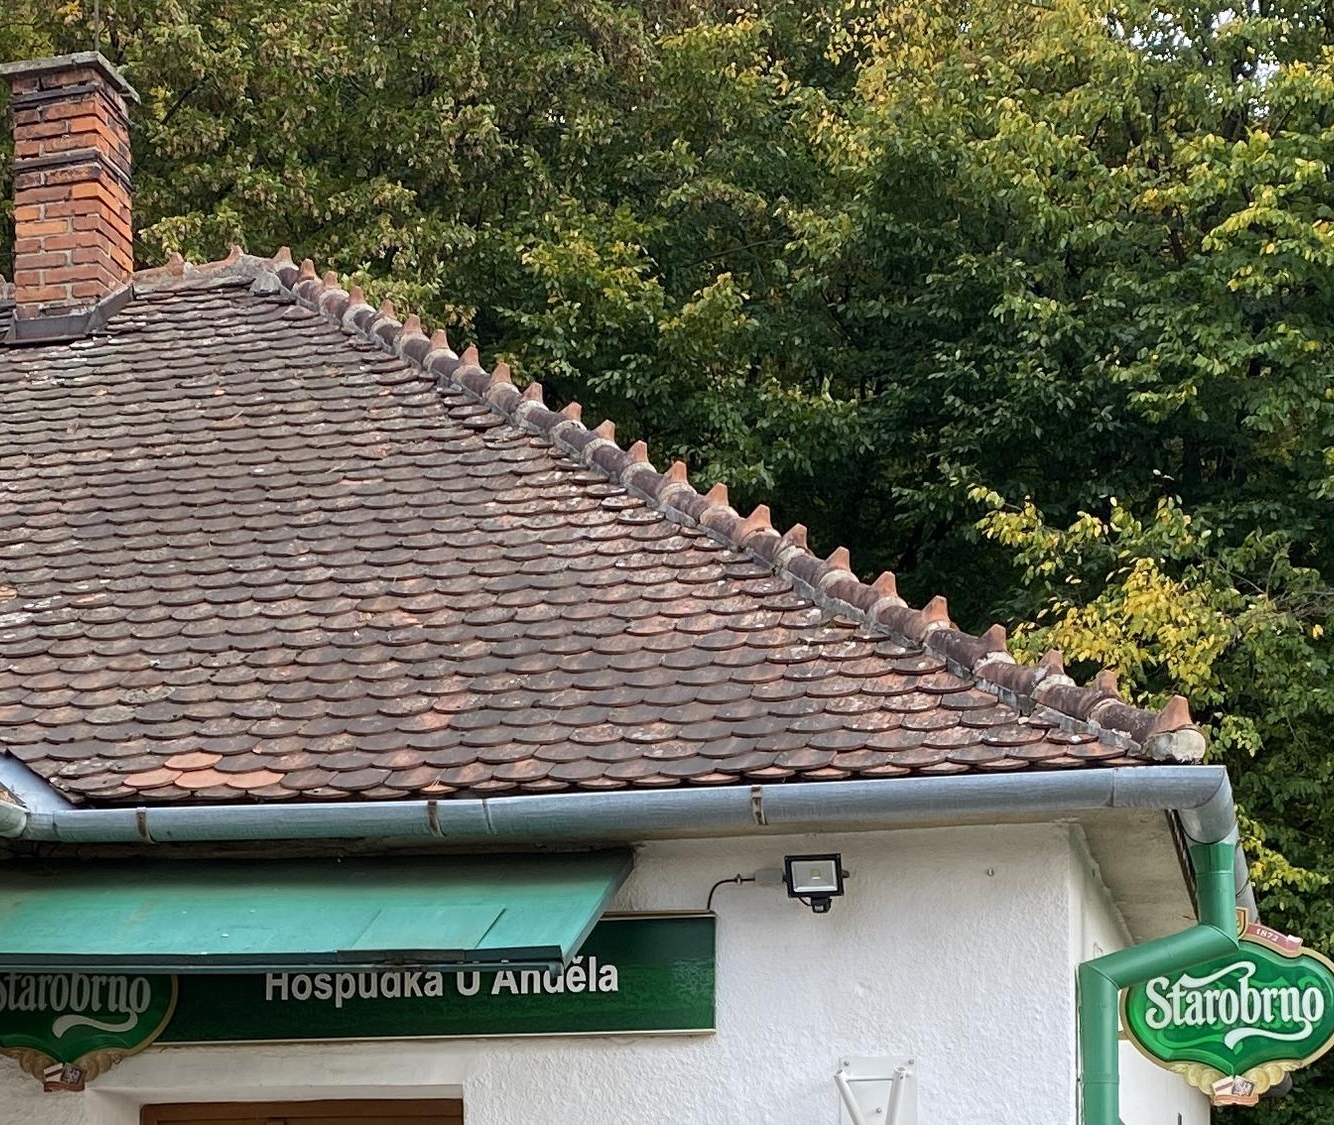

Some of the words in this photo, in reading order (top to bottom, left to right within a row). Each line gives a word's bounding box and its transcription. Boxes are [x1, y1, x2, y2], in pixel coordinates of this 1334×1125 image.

[1257, 928, 1280, 942] 1872
[457, 971, 481, 996] U
[491, 956, 619, 995] Anděla
[1145, 961, 1325, 1050] Starobrno
